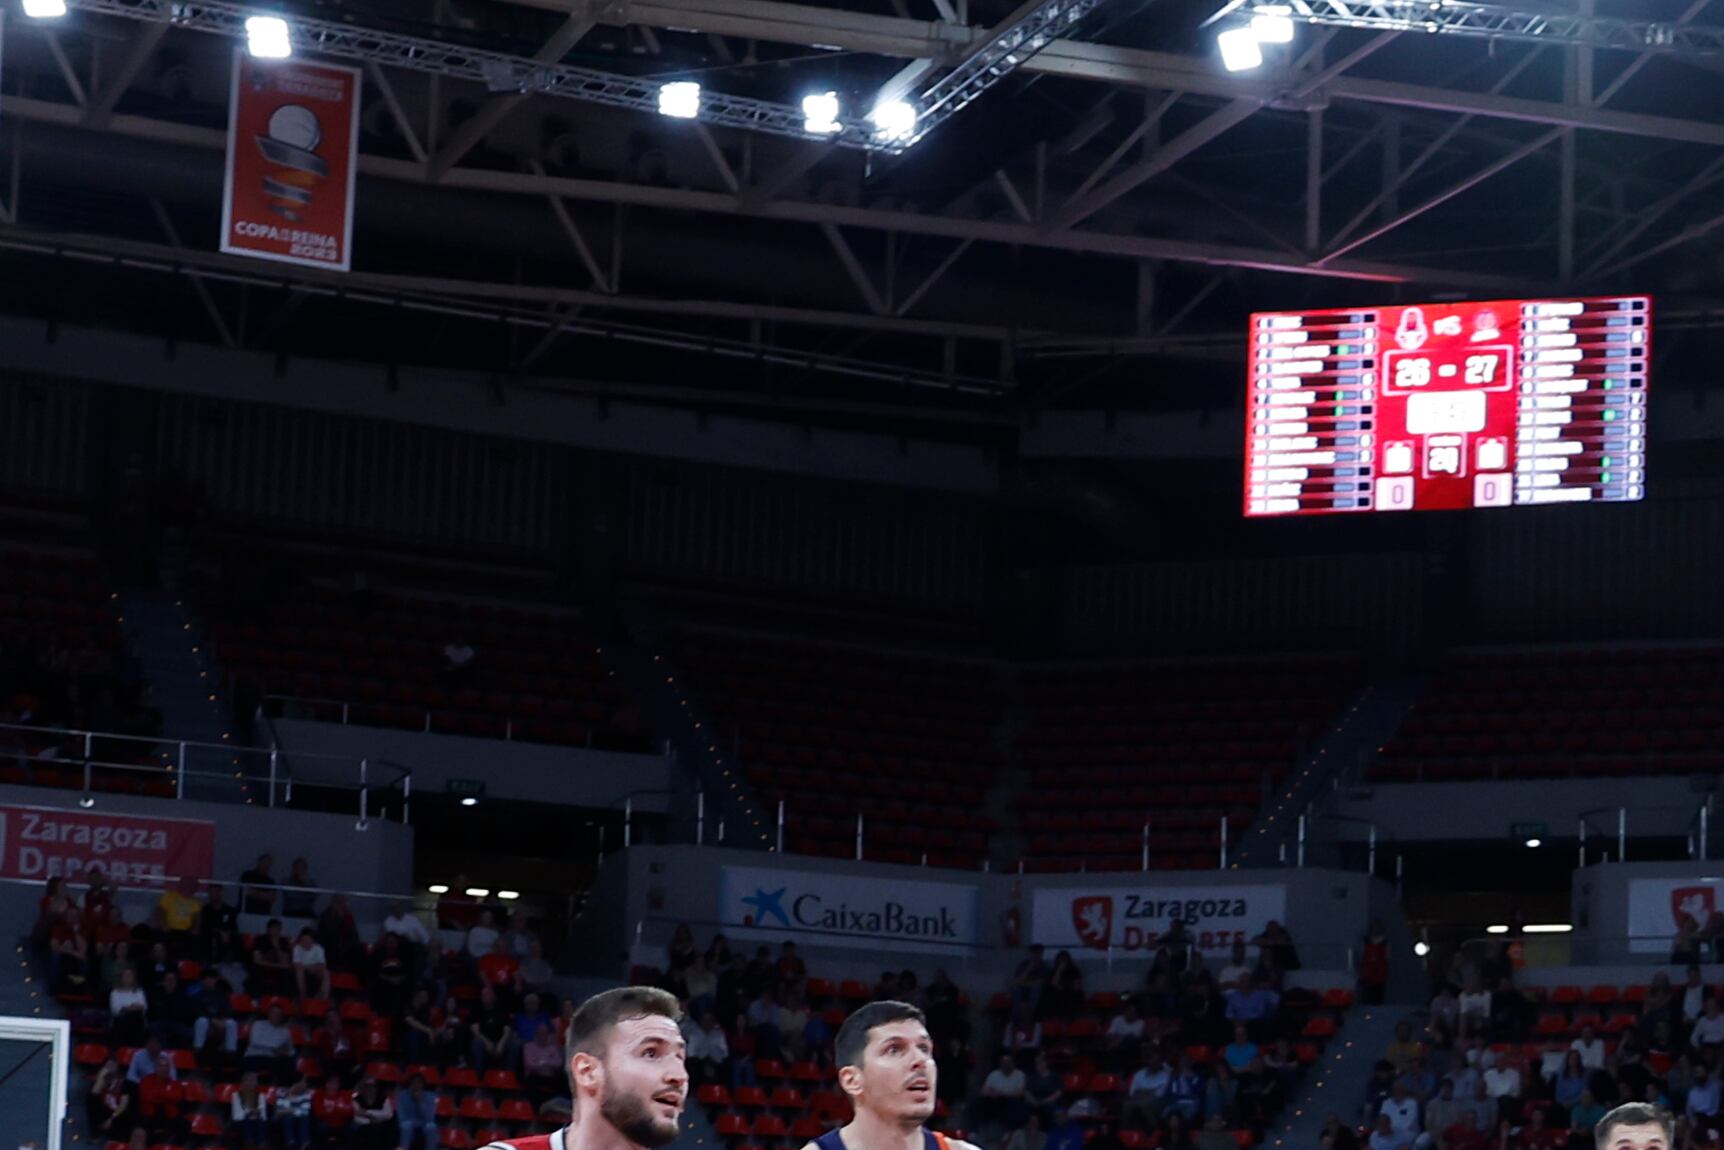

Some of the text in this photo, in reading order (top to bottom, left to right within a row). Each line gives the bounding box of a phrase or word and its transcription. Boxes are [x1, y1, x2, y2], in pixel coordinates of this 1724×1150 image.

[1465, 354, 1498, 384] 27
[1392, 484, 1404, 505] 0
[1484, 481, 1496, 502] 0
[20, 812, 168, 854] Zaragoza
[793, 894, 958, 938] CaixaBank
[1125, 894, 1247, 926] Zaragoza
